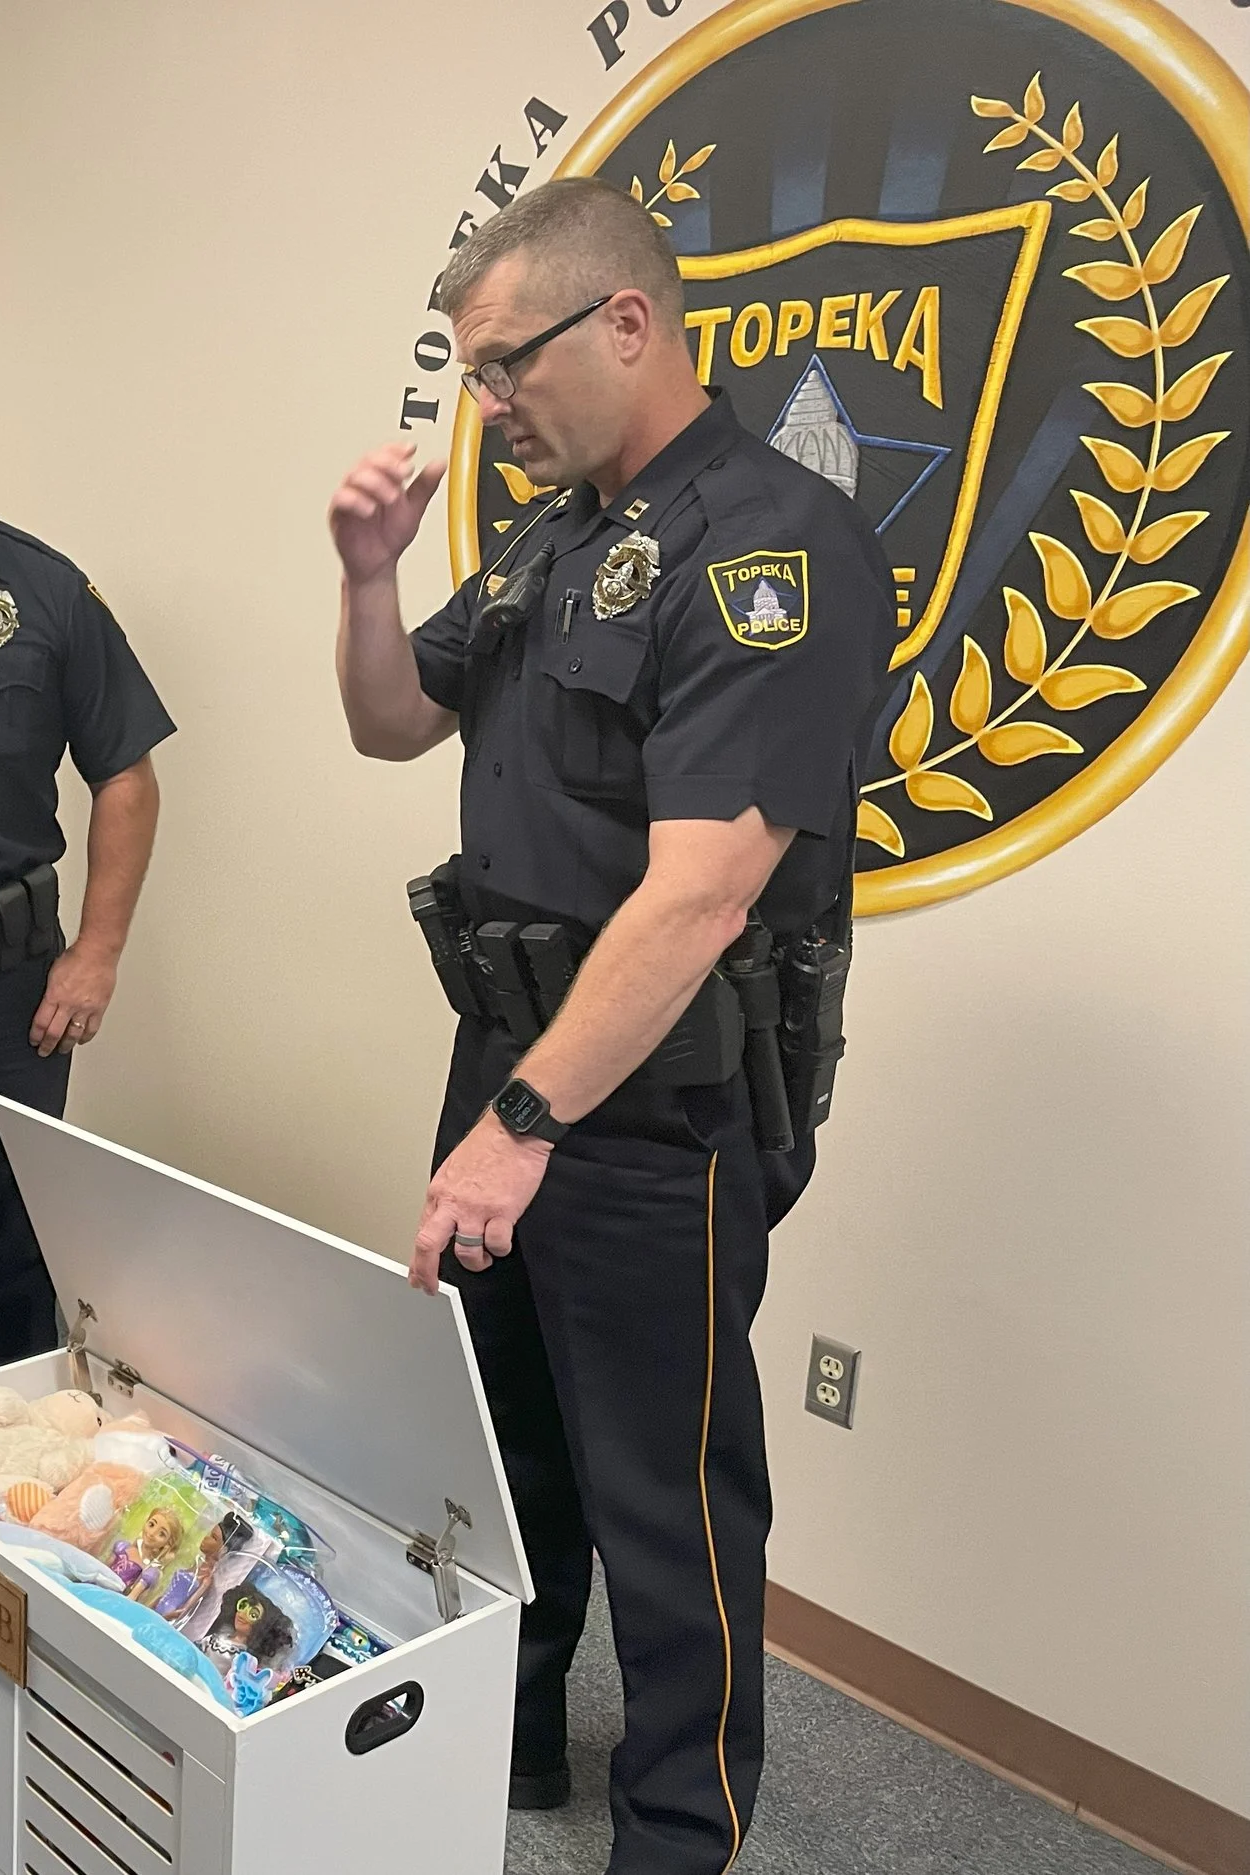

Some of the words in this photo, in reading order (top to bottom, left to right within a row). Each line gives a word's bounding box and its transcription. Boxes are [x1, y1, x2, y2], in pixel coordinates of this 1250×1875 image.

[684, 286, 943, 410] TOPEKA
[722, 563, 797, 592] TOPEKA
[736, 618, 802, 636] POLICE
